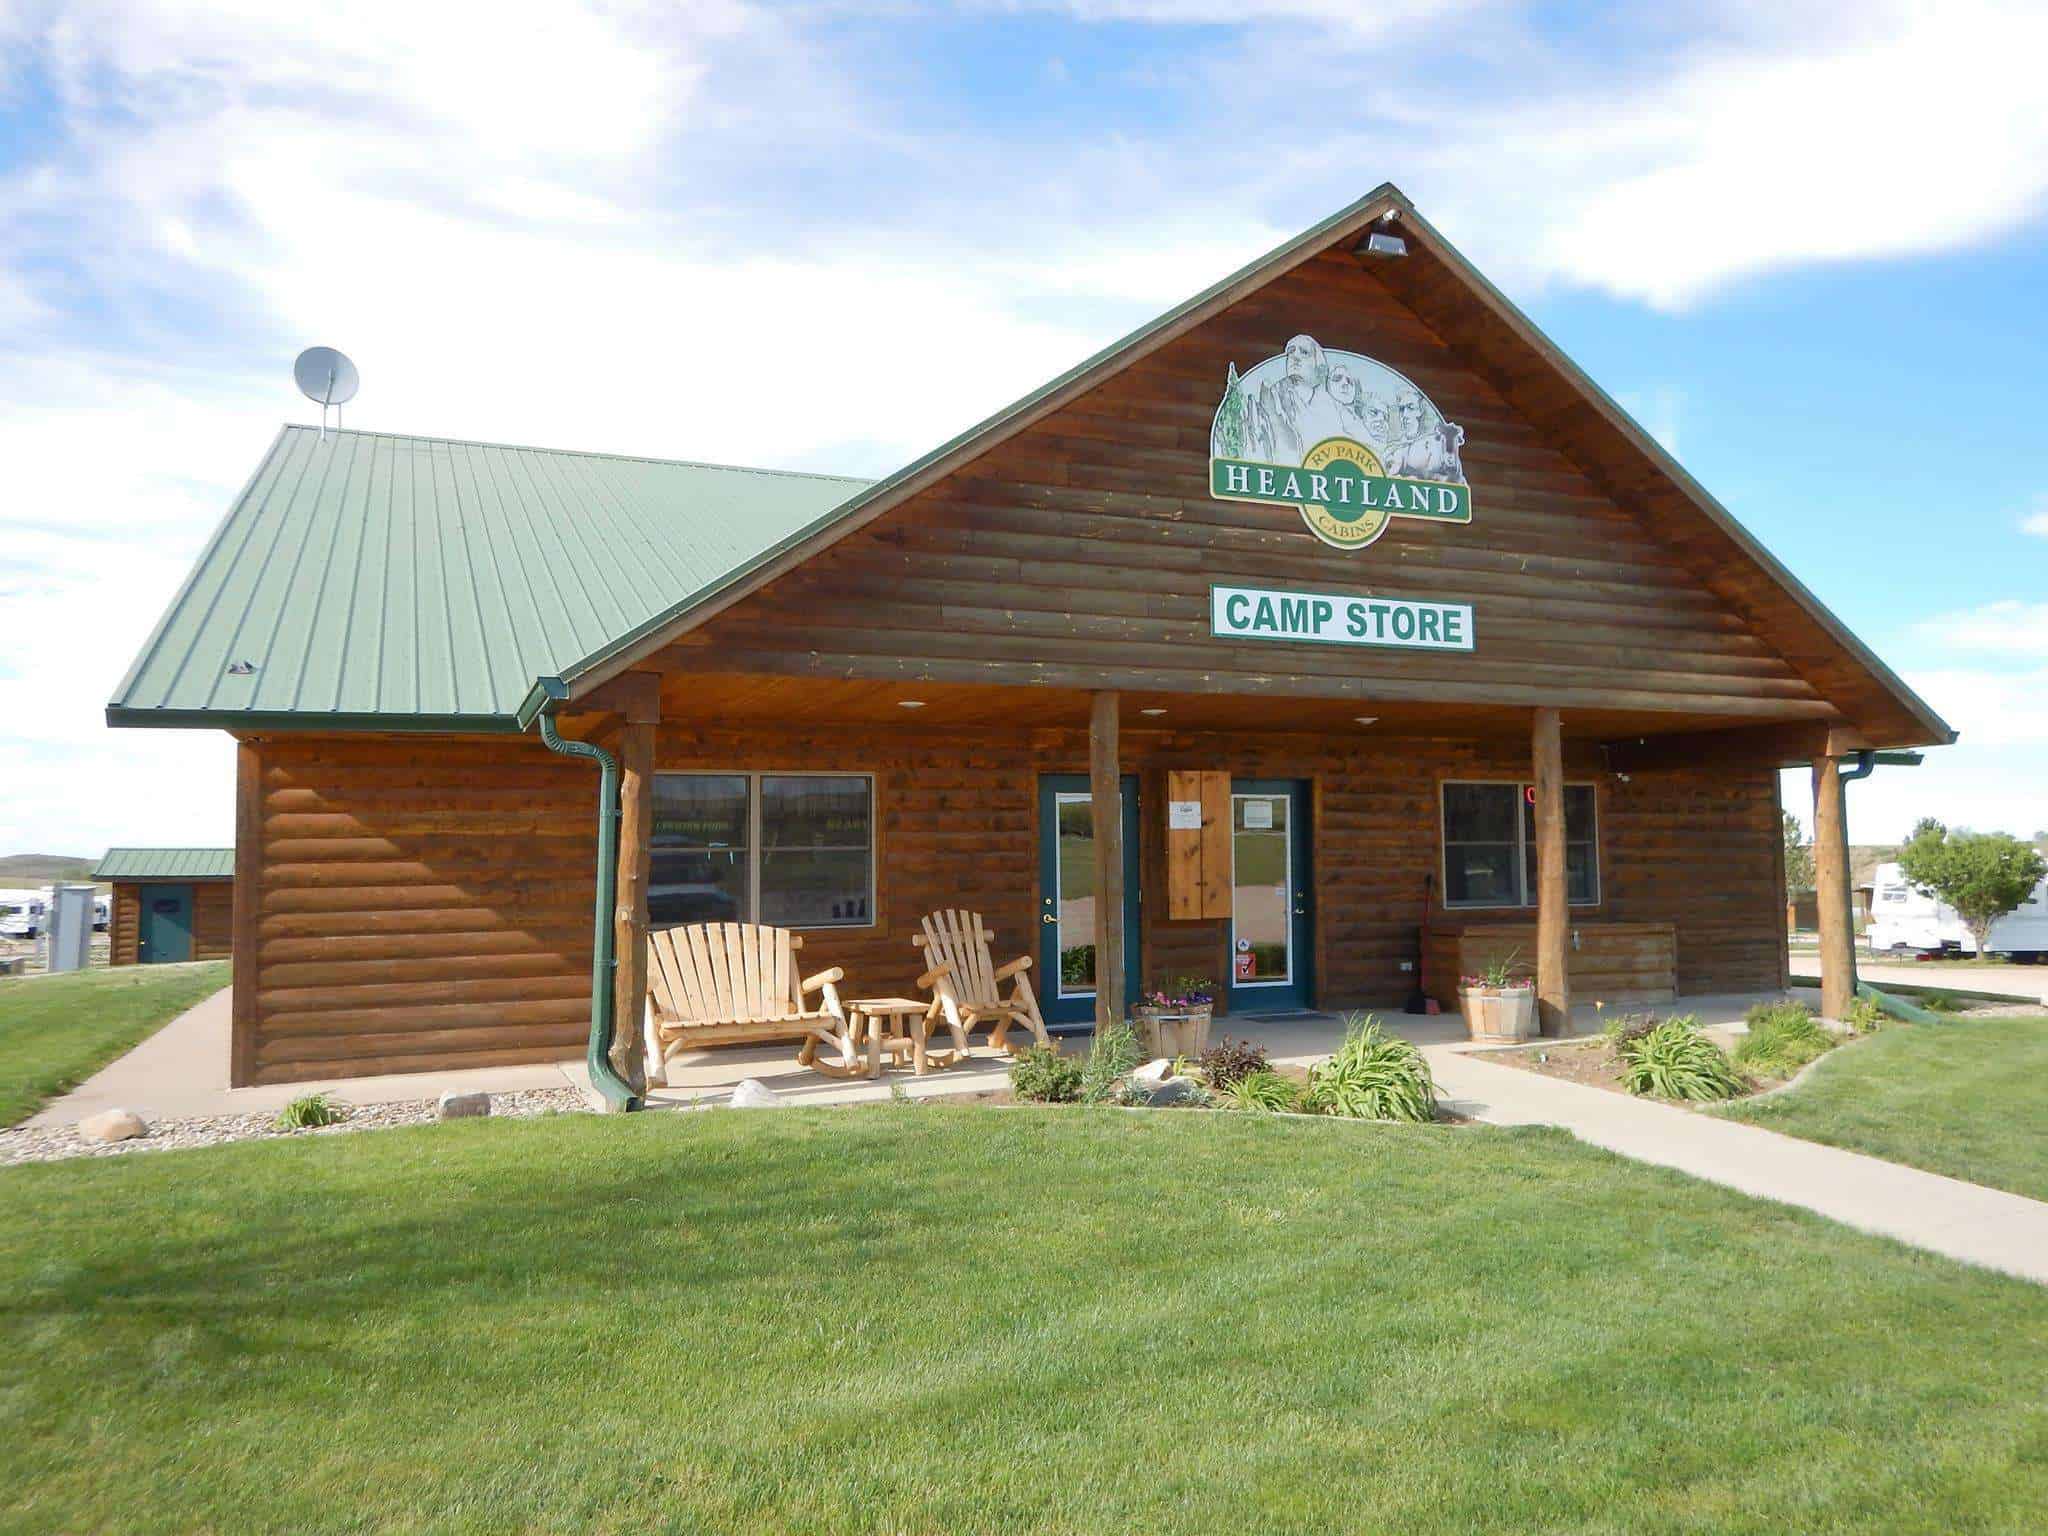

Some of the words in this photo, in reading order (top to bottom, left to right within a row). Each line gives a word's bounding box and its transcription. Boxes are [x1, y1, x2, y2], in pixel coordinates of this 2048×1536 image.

[1312, 447, 1331, 466] RV
[1334, 446, 1376, 472] PARK
[1225, 464, 1459, 515] HEARTLAND
[1318, 515, 1375, 538] CABINS
[1225, 593, 1333, 634] CAMP
[1346, 602, 1463, 643] STORE
